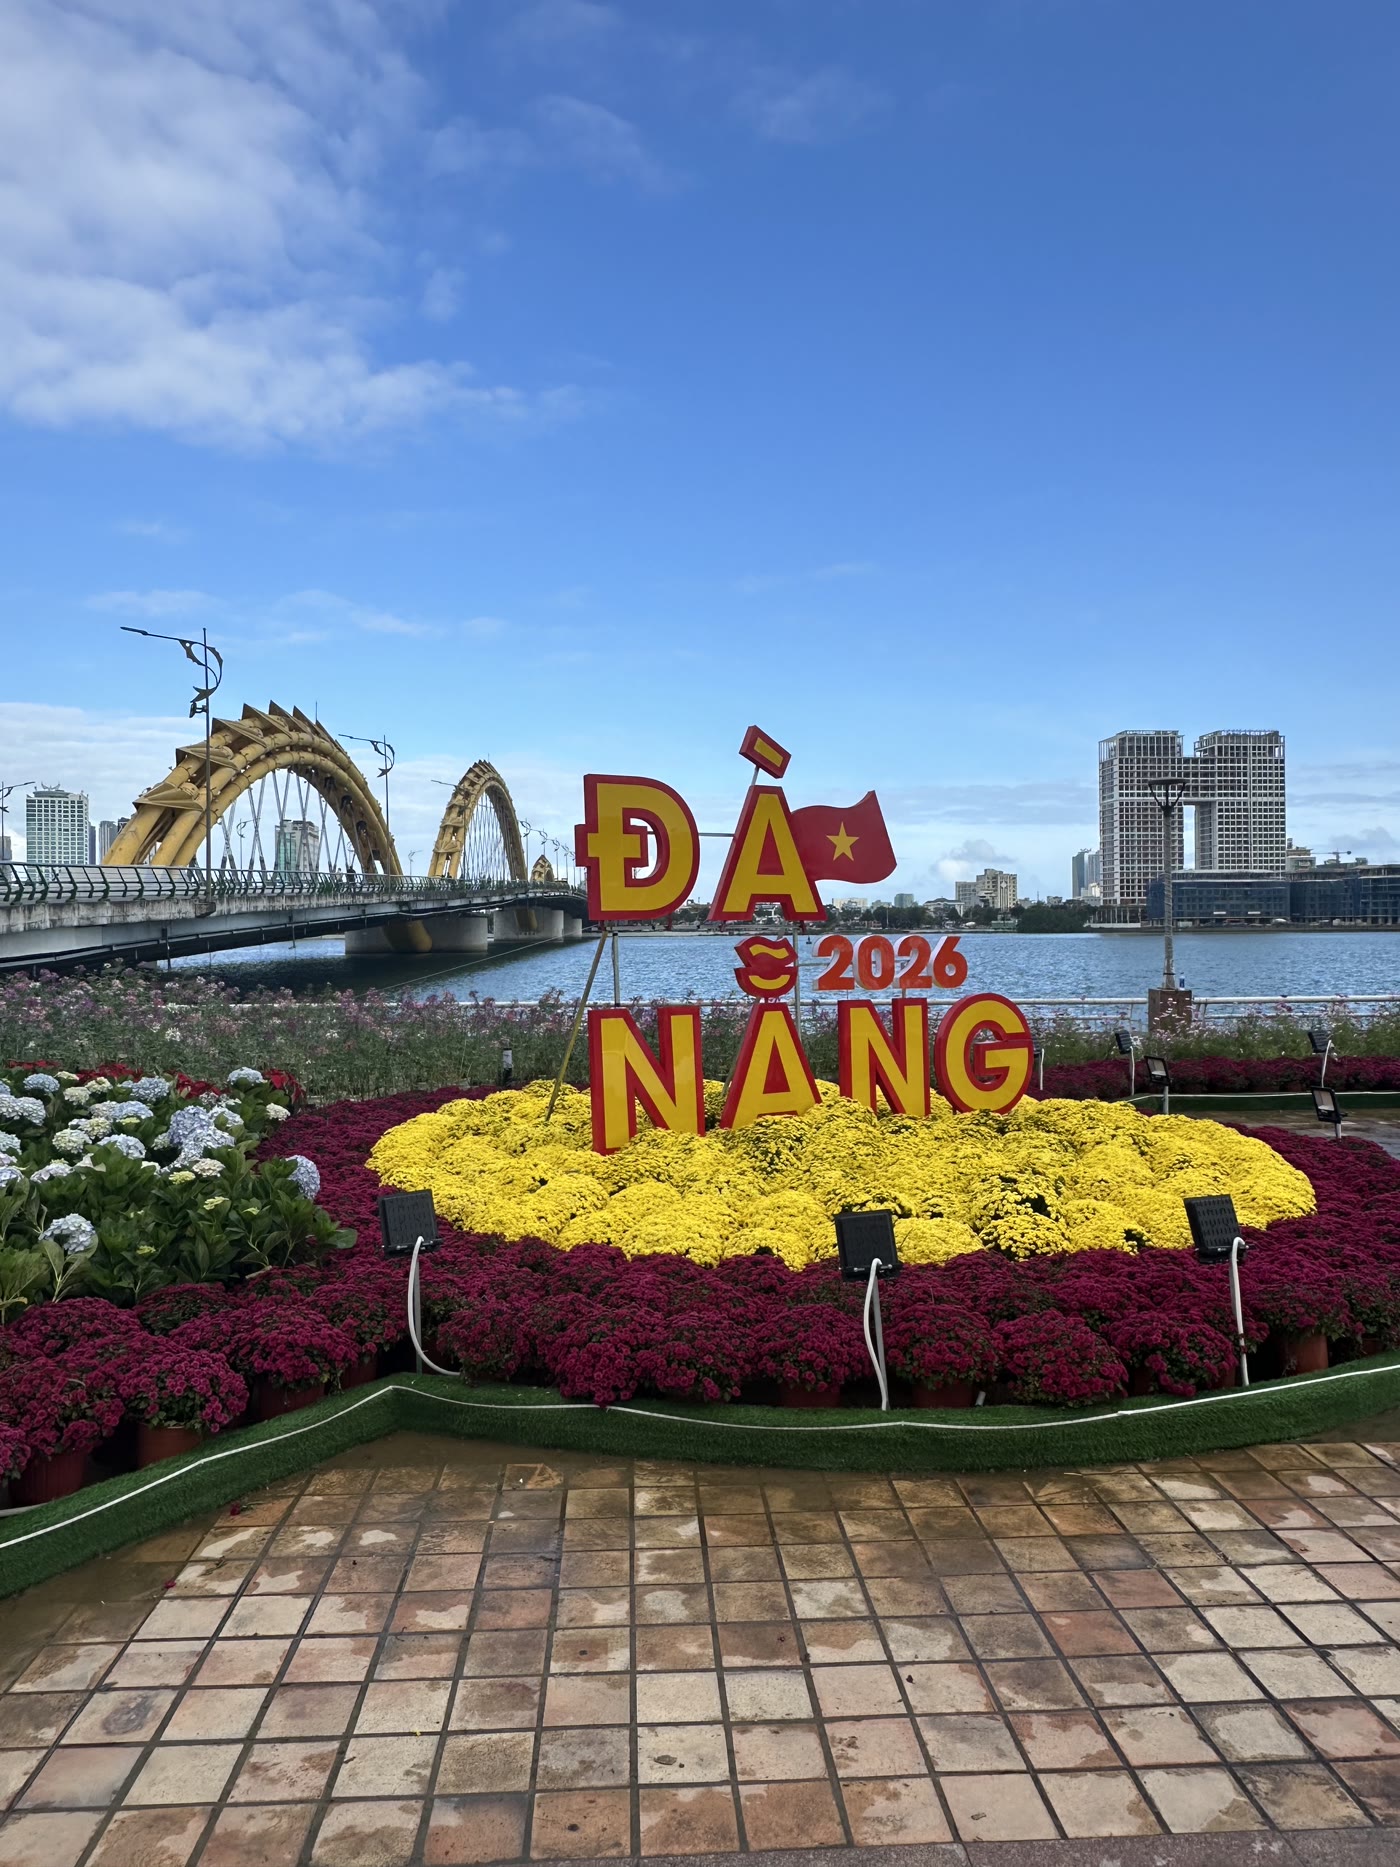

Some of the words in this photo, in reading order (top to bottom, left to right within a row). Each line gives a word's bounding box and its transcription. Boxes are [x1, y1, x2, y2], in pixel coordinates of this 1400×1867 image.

[575, 725, 827, 921] ĐÀ
[588, 936, 1034, 1154] NẴNG
[812, 935, 969, 991] 2026
